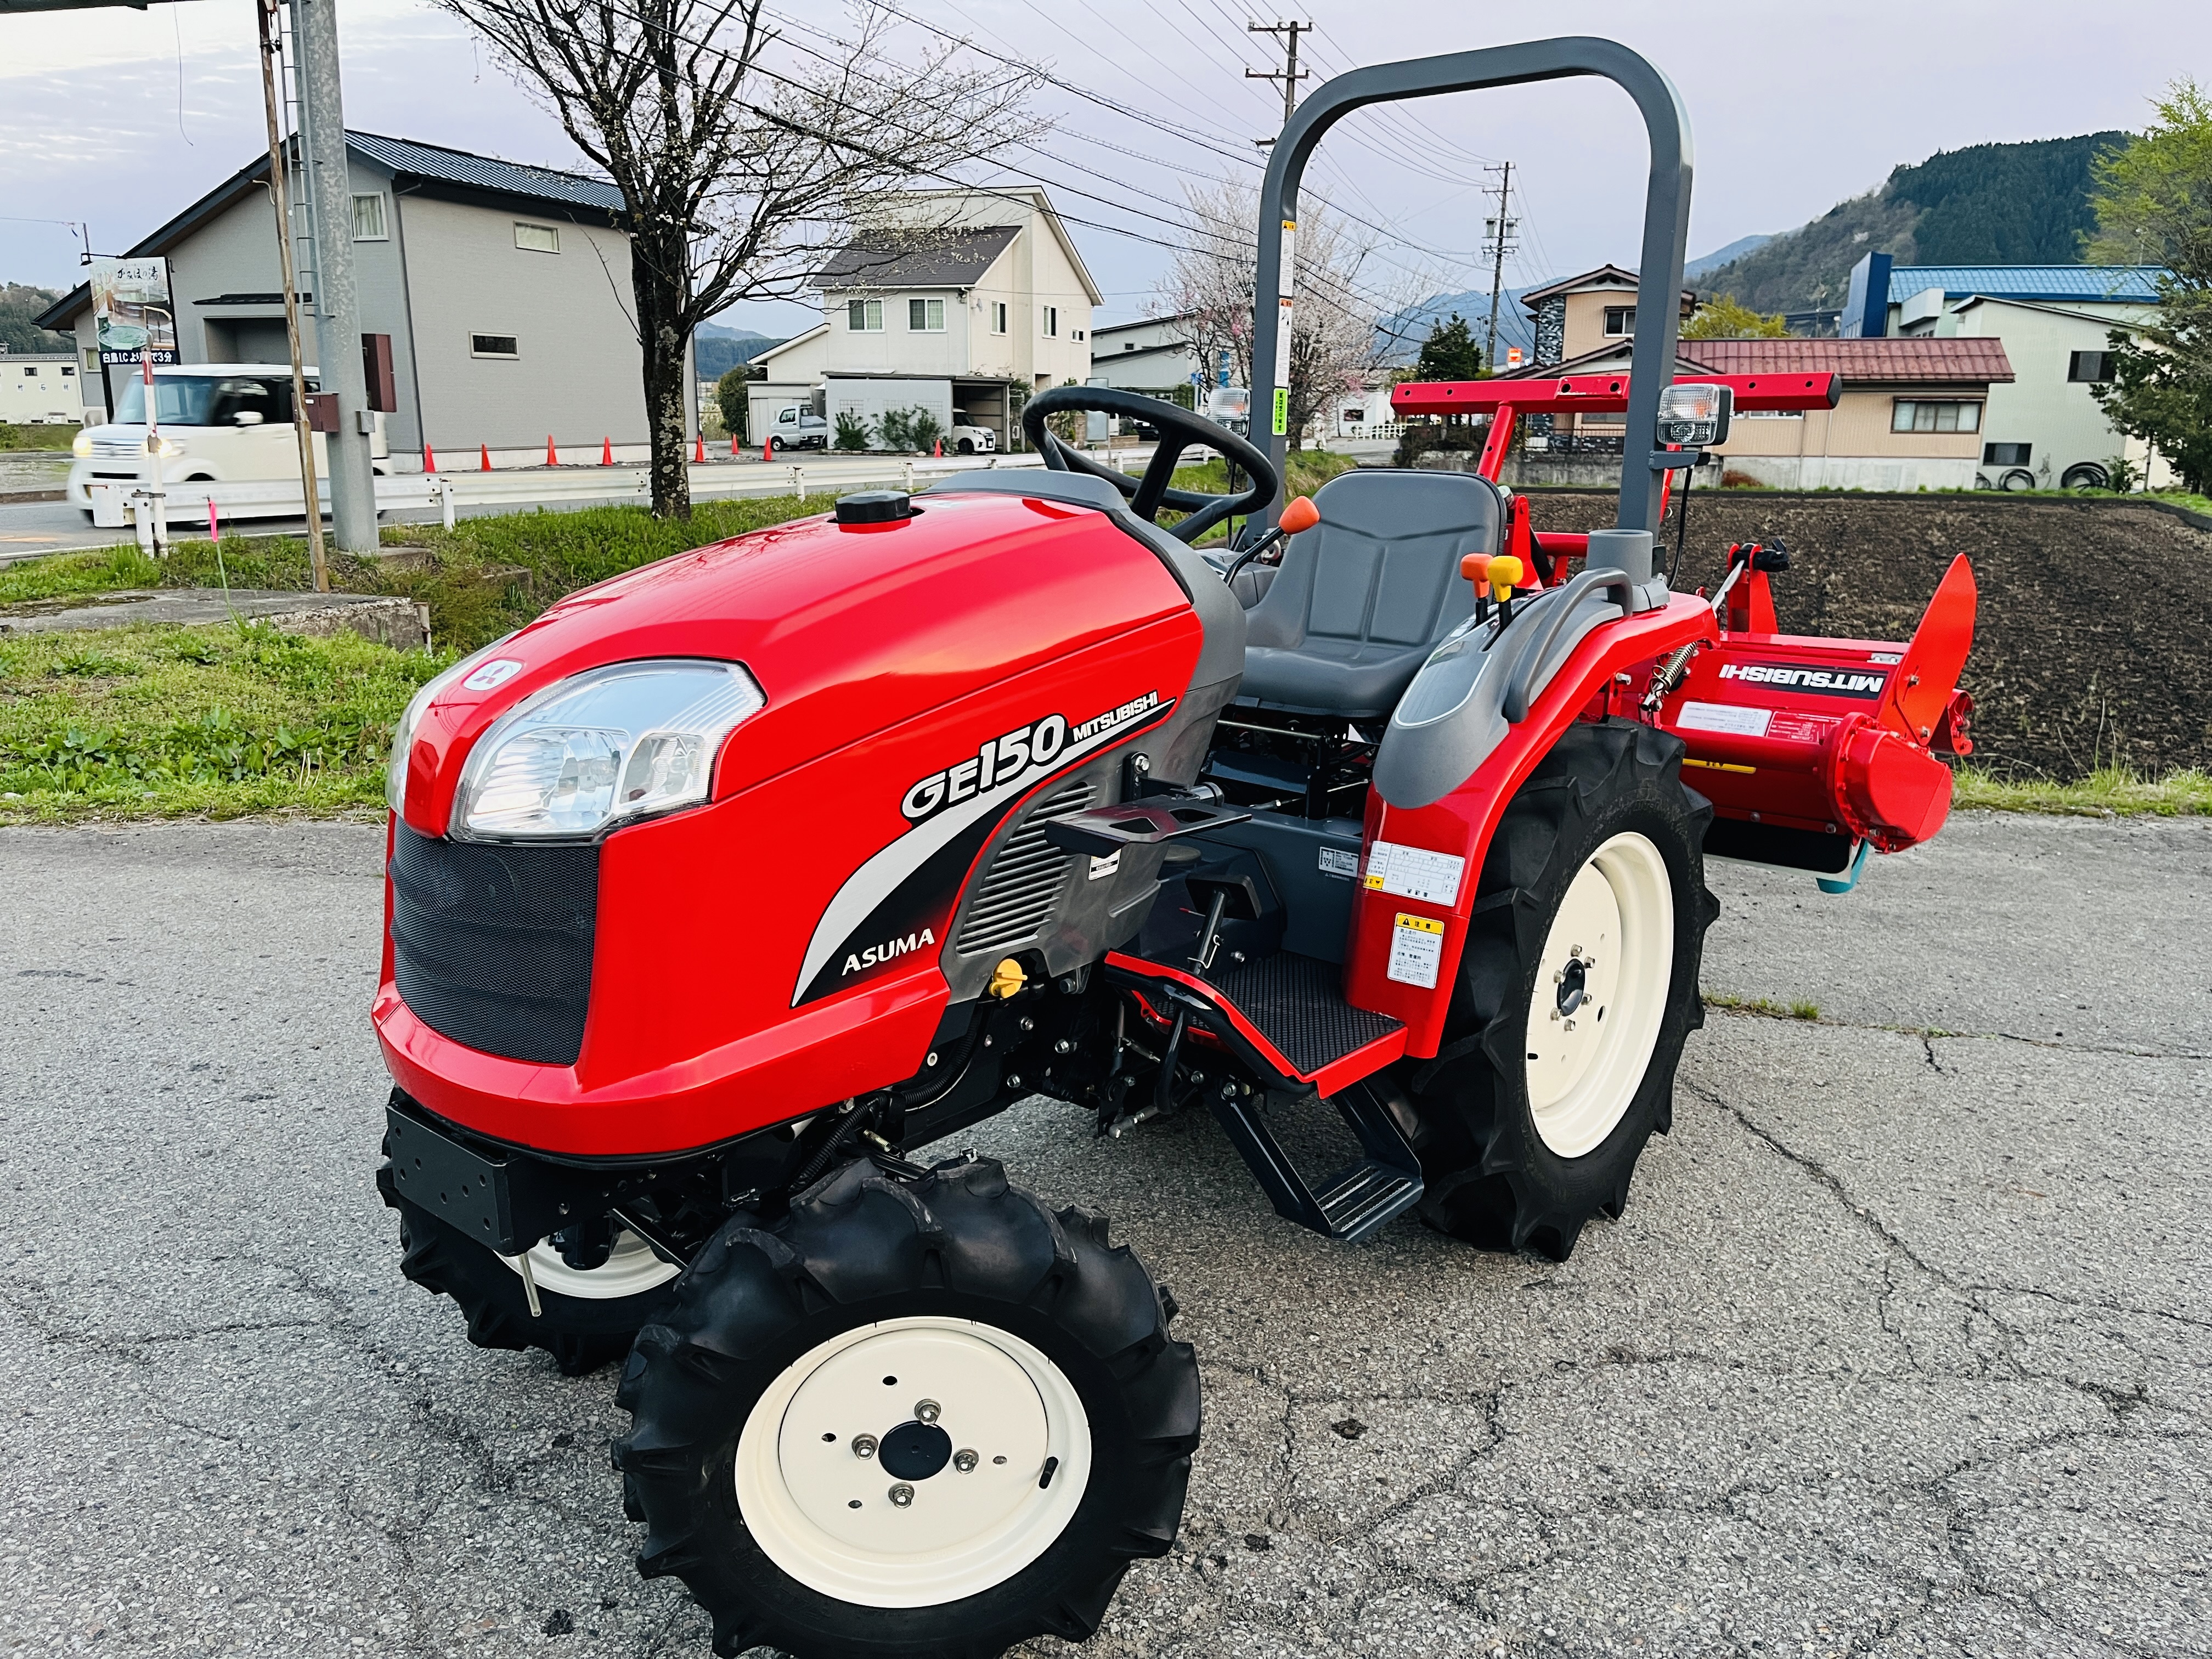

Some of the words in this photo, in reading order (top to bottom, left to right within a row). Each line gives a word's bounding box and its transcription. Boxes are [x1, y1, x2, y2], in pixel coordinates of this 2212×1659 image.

[1718, 664, 1884, 692] MITSUBISHI
[902, 714, 1065, 818] GE150
[1073, 691, 1158, 742] MITSUBISHI
[842, 928, 935, 976] ASUMA
